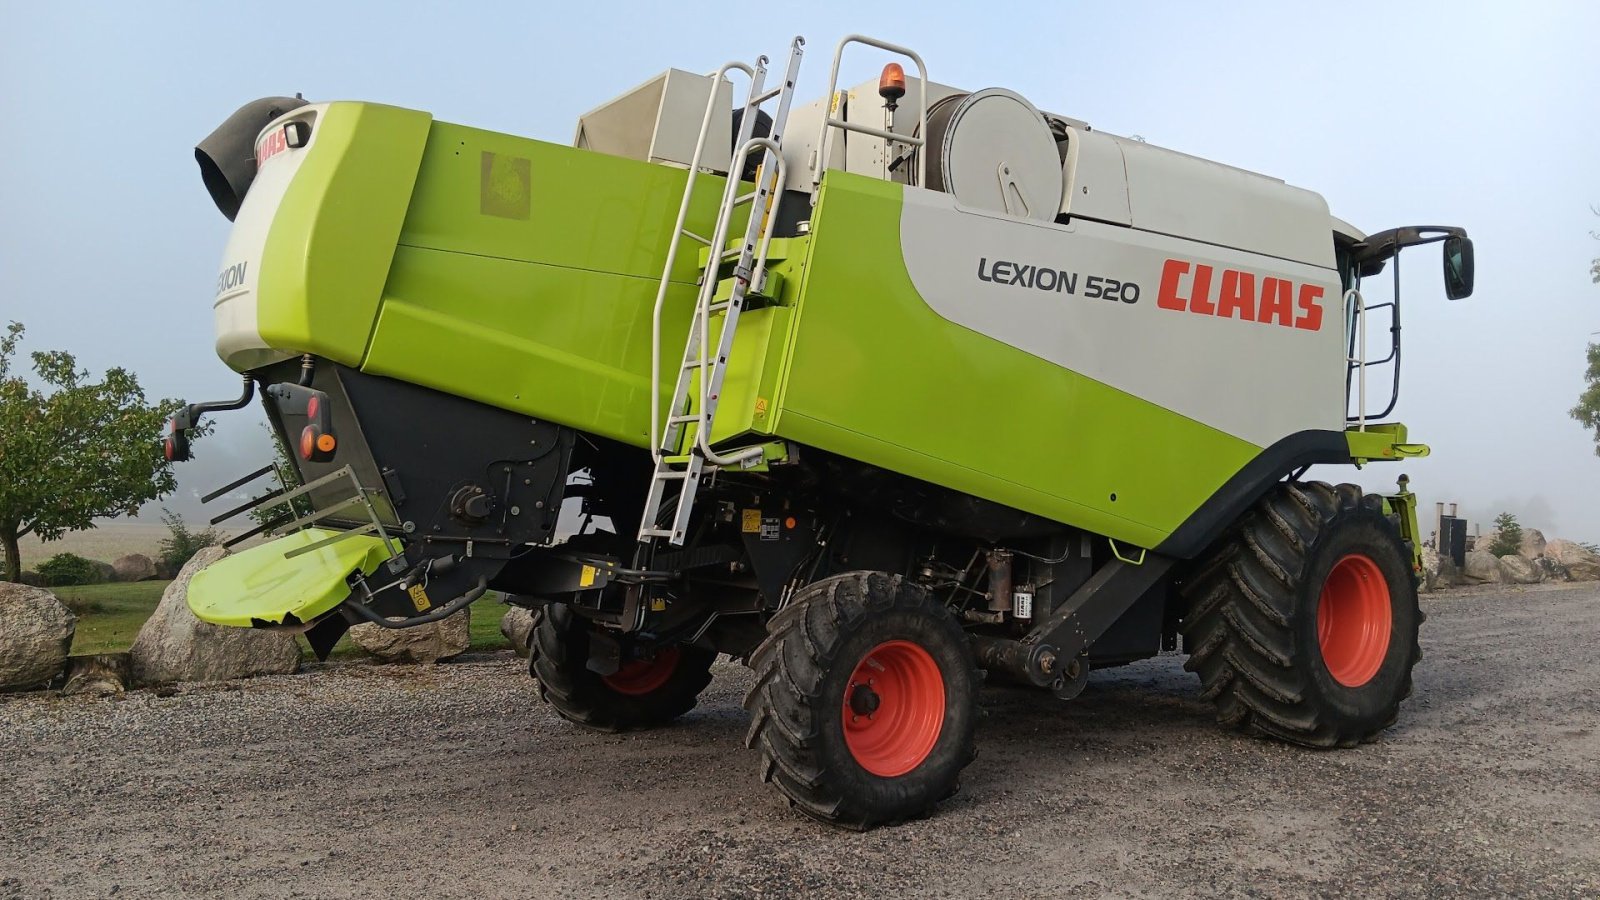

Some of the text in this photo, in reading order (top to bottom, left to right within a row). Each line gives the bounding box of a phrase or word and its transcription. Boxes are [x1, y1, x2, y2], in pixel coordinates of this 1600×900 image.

[977, 257, 1140, 304] LEXION 520
[1157, 258, 1324, 331] CLAAS
